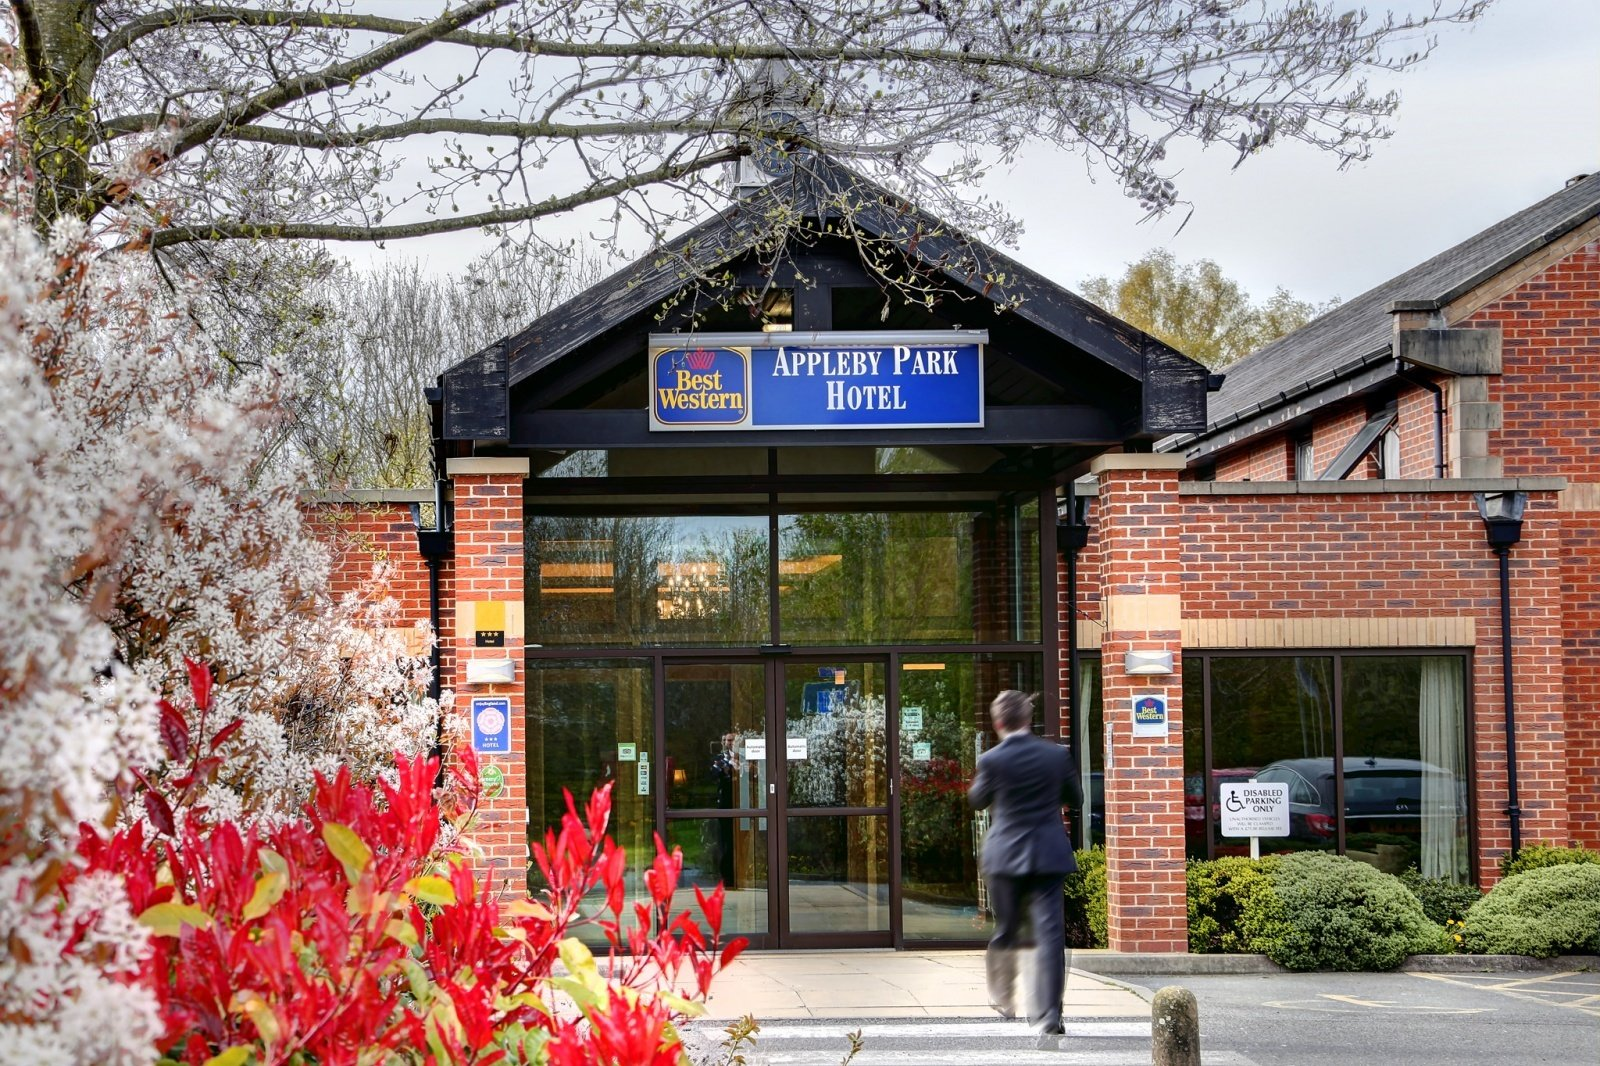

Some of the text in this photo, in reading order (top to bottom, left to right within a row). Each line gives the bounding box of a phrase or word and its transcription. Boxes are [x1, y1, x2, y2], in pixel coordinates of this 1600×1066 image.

[772, 346, 959, 376] APPLEBY PARK
[676, 370, 722, 391] Best
[658, 388, 744, 410] Western
[826, 380, 906, 410] HOTEL
